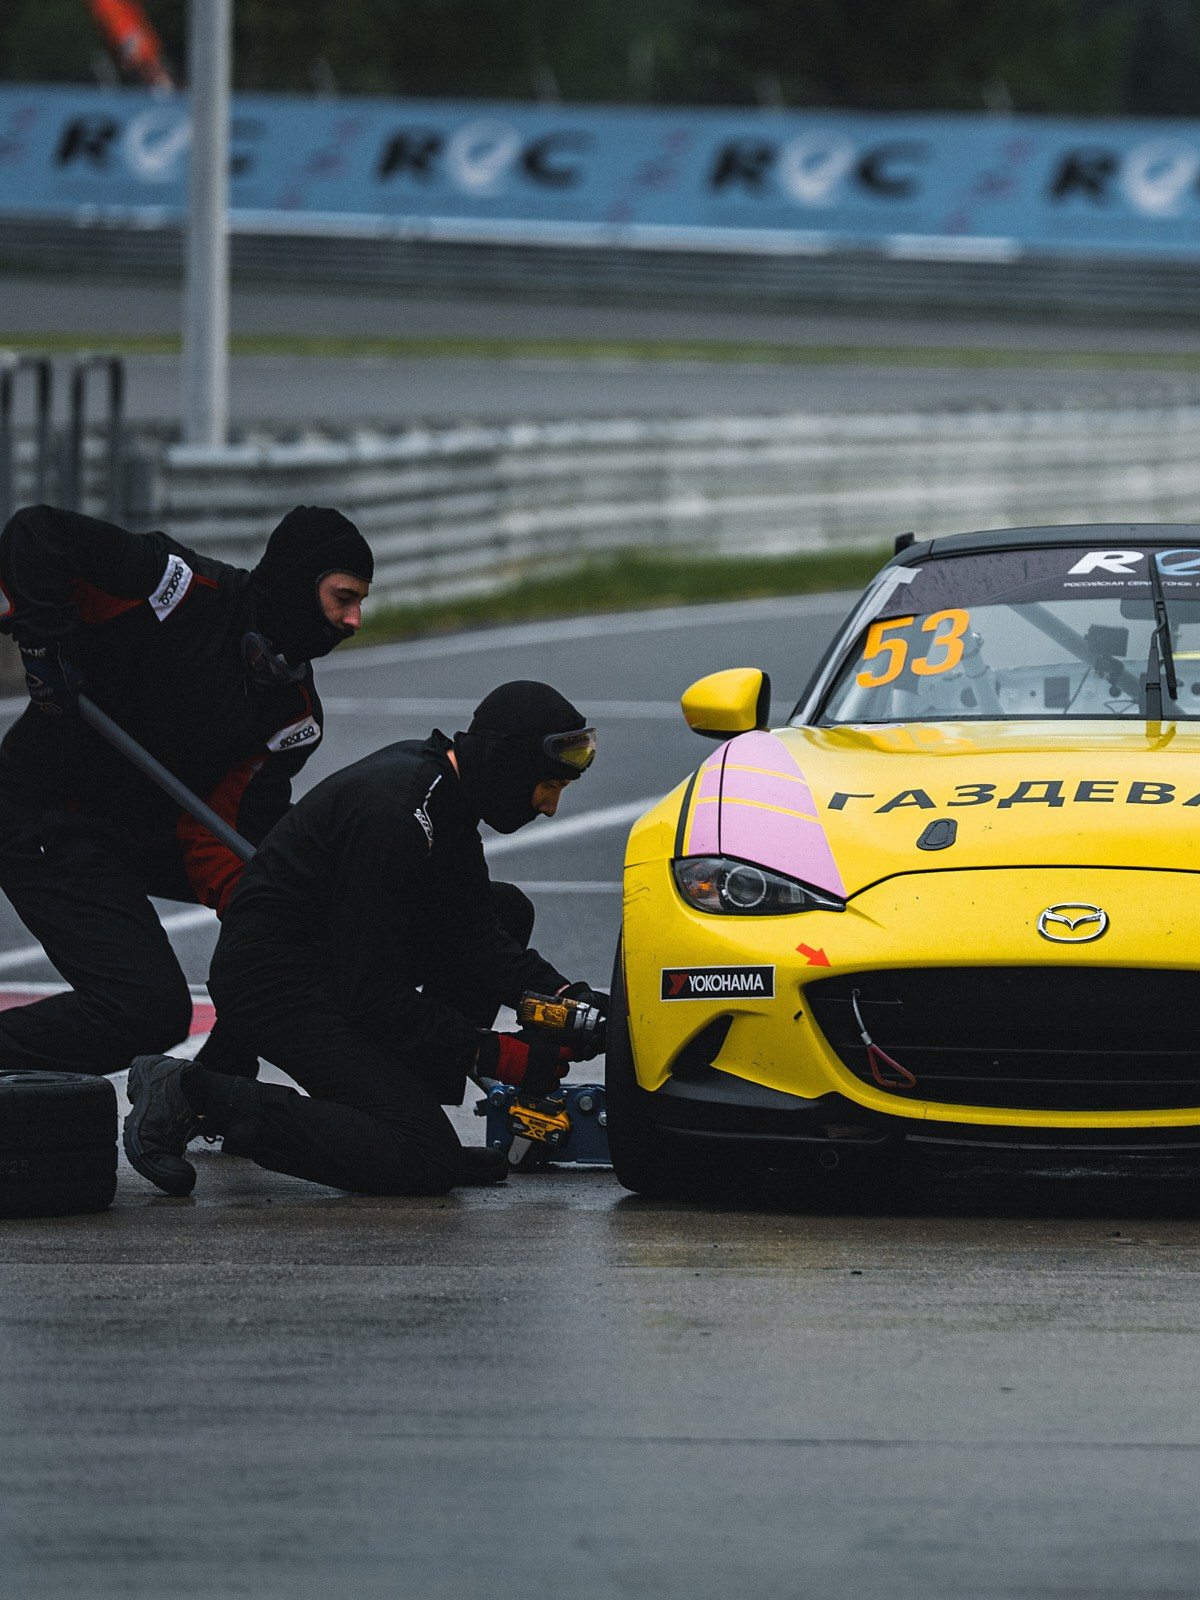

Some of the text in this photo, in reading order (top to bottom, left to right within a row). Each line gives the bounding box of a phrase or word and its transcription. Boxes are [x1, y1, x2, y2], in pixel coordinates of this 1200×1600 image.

[160, 563, 184, 606] sparco
[1063, 580, 1125, 588] РОССИЙСКАЯ
[856, 608, 970, 688] 53
[279, 725, 316, 750] sparco
[689, 973, 765, 992] YOKOHAMA
